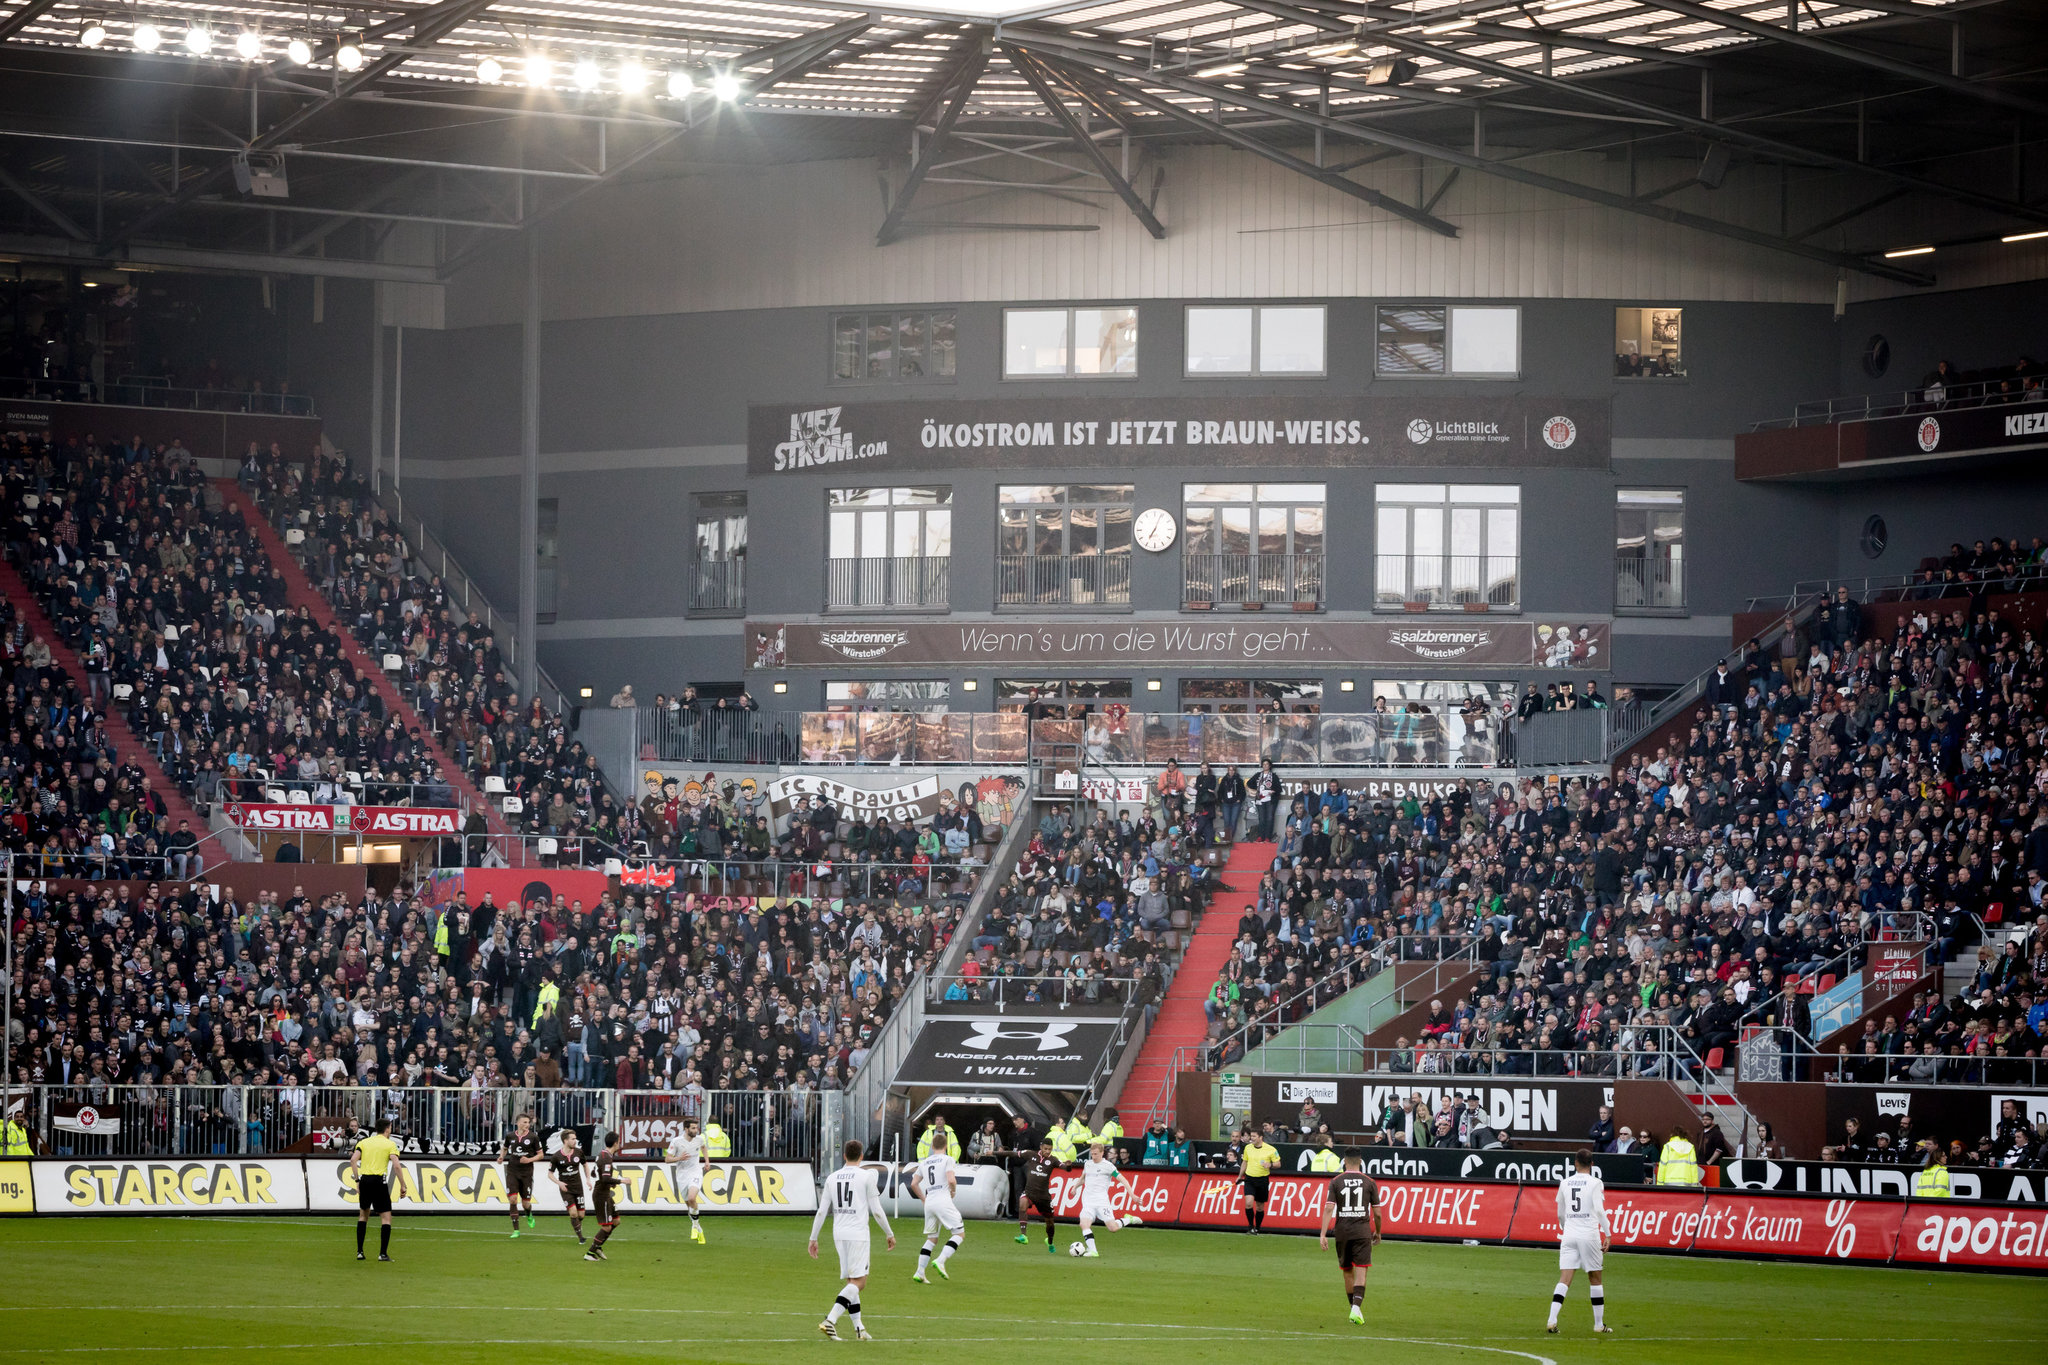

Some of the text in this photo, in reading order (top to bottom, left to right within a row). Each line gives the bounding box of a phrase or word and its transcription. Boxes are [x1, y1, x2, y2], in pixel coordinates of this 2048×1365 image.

[790, 406, 842, 442] KIEZ
[921, 419, 1369, 448] ÖKOSTROM IST JETZT BRAUN-WEISS.
[1436, 421, 1498, 434] LichtBlick
[2005, 412, 2048, 437] KIEZ
[1487, 434, 1510, 443] Energie
[829, 629, 898, 646] salzbrenner
[1061, 633, 1104, 652] um
[1113, 627, 1156, 652] die
[1163, 627, 1238, 652] Wurst
[1242, 627, 1332, 658] geht...
[1400, 629, 1478, 645] salzbrenner
[842, 644, 887, 659] Würstchen
[1415, 643, 1466, 659] Würstchen
[780, 778, 805, 796] FC
[817, 780, 847, 802] ST.
[245, 809, 329, 829] ASTRA
[373, 813, 455, 832] ASTRA
[934, 1052, 998, 1060] UNDER
[963, 1065, 973, 1074] I
[1293, 1087, 1303, 1097] Die
[1305, 1087, 1334, 1098] Techniker
[64, 1163, 278, 1208] STARCAR
[927, 1165, 935, 1185] 6
[1796, 1166, 1982, 1200] UNDR
[836, 1181, 853, 1208] 14
[1048, 1174, 1169, 1216] apal.de
[1194, 1180, 1245, 1215] IHRE
[1340, 1186, 1365, 1211] 11
[1571, 1187, 1581, 1212] 5
[1669, 1205, 1738, 1246] geht's
[1741, 1205, 1803, 1243] kaum
